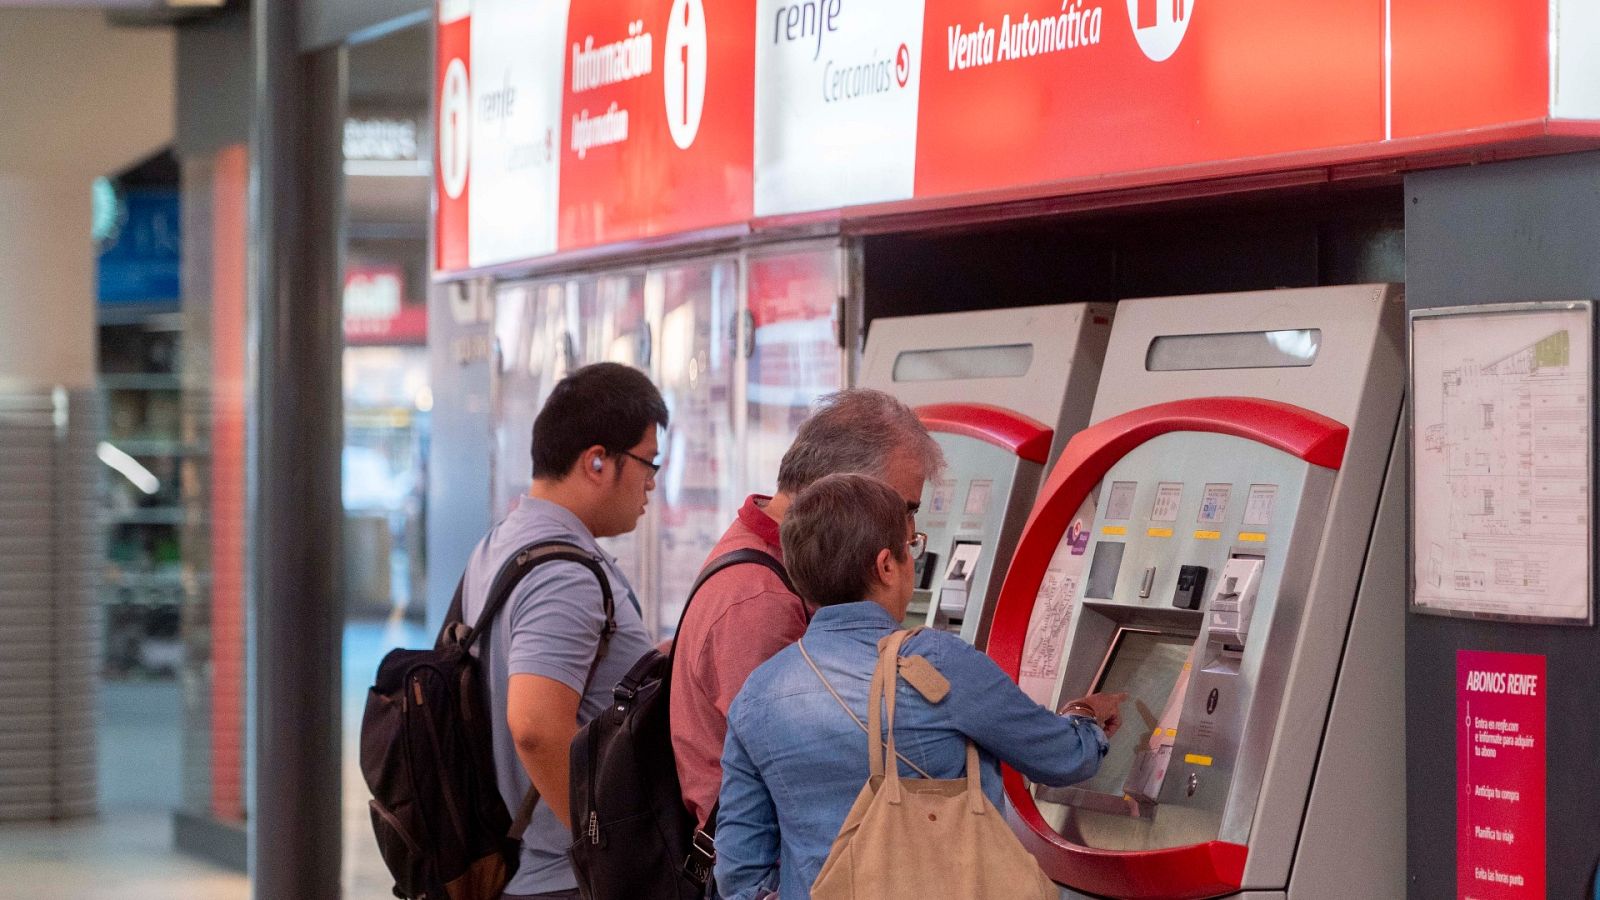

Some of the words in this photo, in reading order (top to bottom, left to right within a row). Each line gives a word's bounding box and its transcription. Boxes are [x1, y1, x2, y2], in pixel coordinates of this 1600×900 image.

[774, 0, 841, 61] renfe
[948, 22, 995, 72] Venta
[997, 0, 1102, 62] Automática
[823, 48, 891, 103] Cercanías
[1466, 671, 1506, 694] ABONOS
[1507, 673, 1538, 696] RENFE
[1475, 717, 1488, 729] Entra
[1488, 720, 1495, 730] en
[1495, 719, 1519, 733] renfe.com
[1475, 745, 1481, 756] tu
[1481, 745, 1497, 758] abono
[1502, 736, 1514, 748] para
[1514, 734, 1535, 750] adquirir
[1475, 785, 1495, 801] Anticipa
[1501, 790, 1520, 804] compra
[1475, 867, 1488, 880] Evita
[1495, 869, 1509, 884] horas
